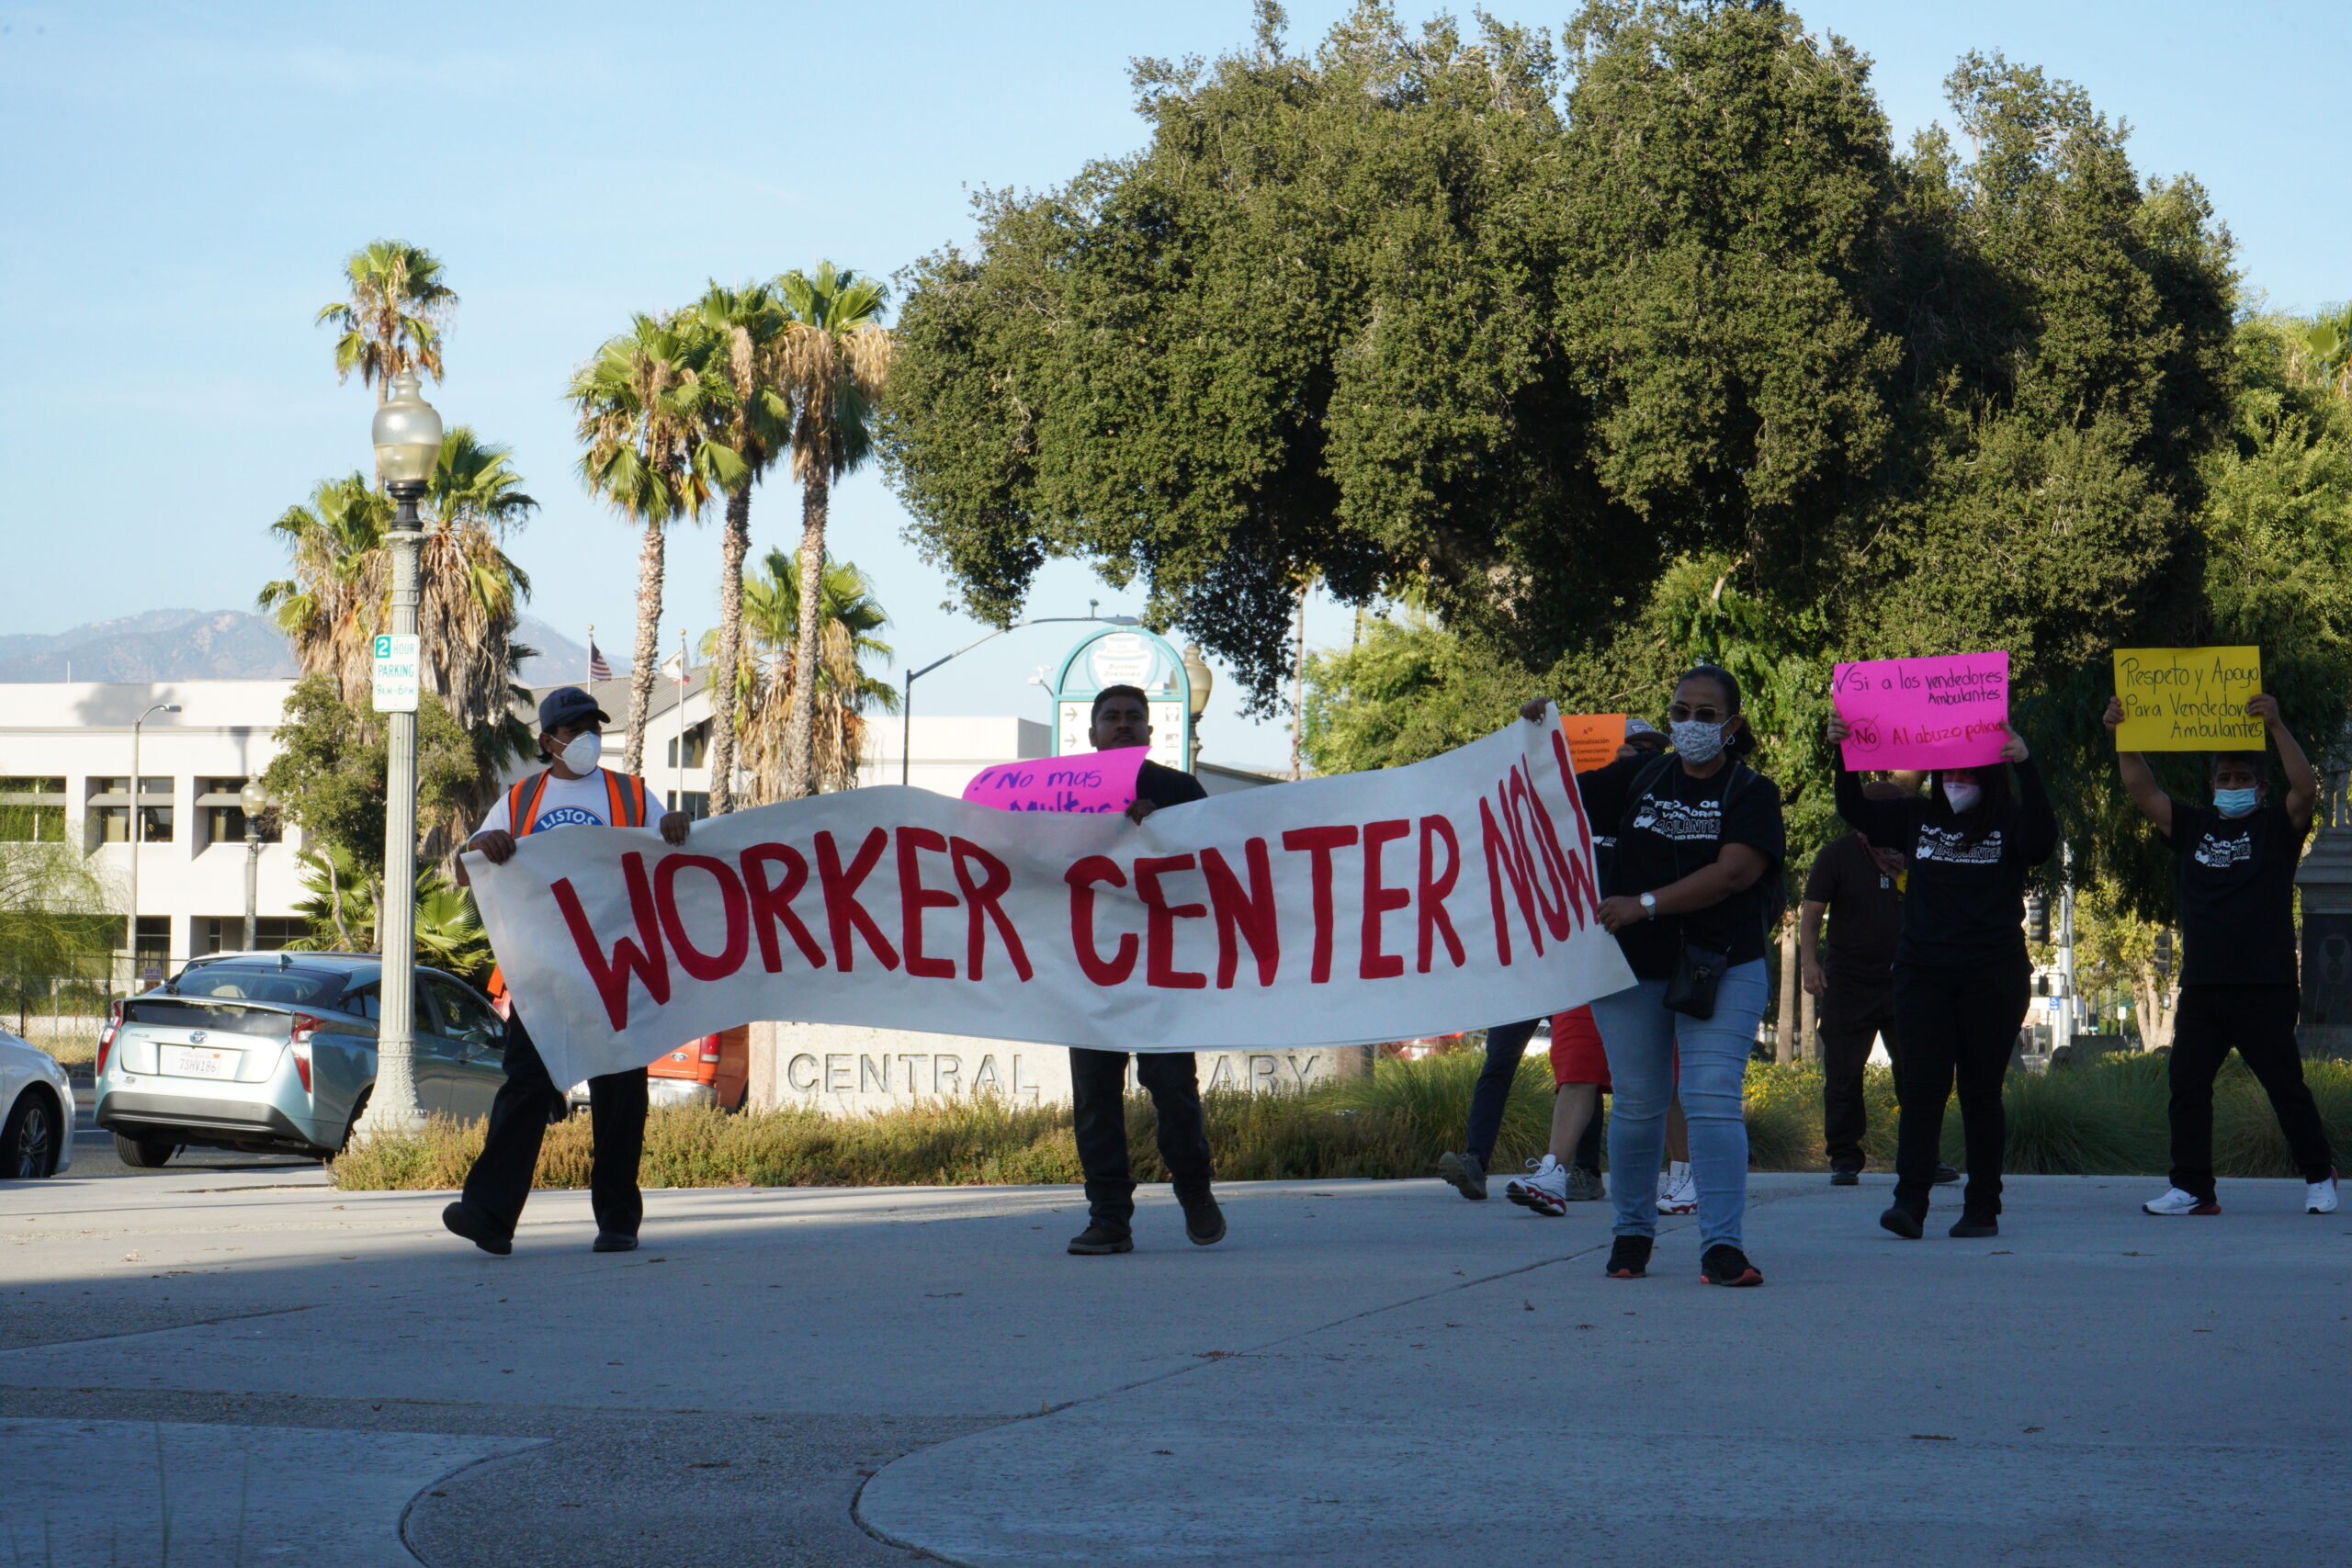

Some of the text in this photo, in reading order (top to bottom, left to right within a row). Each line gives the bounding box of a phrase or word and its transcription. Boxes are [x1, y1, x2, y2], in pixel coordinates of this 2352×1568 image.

[378, 638, 414, 656] 2 HOUR
[378, 664, 414, 678] PARKING
[1849, 671, 1870, 692] Si
[1881, 677, 1893, 691] a
[1898, 665, 1920, 691] los
[2120, 655, 2259, 695] Respeto y Apoyo
[2125, 692, 2249, 718] Para Vendedore
[1854, 728, 1877, 745] No
[1893, 727, 1910, 746] Al
[1915, 725, 1962, 744] abuzo
[1046, 770, 1102, 788] mas
[551, 827, 1033, 1031] WORKER
[1066, 815, 1466, 989] CENTER
[787, 1053, 1041, 1095] CENTRAL
